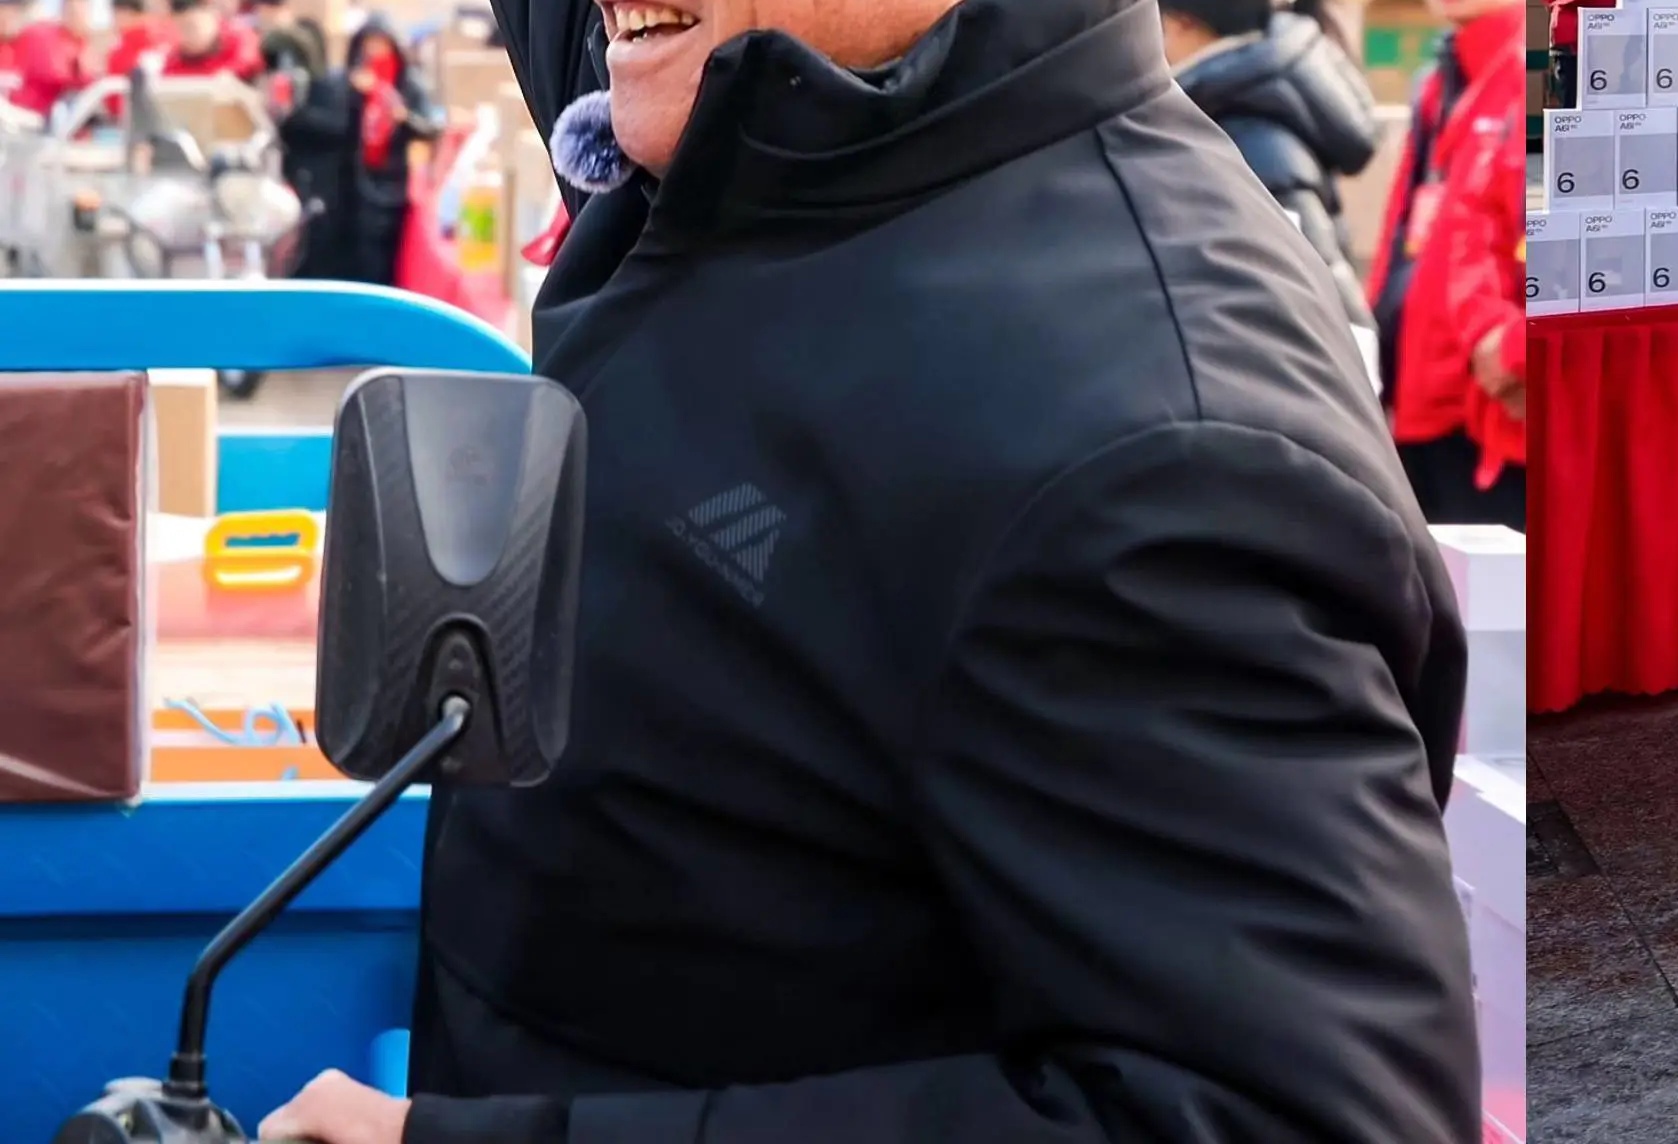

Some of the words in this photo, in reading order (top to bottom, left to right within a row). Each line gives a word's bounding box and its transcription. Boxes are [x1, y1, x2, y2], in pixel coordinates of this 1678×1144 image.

[1555, 116, 1582, 124] OPPO
[1619, 113, 1647, 122] OPPO
[1557, 172, 1575, 193] 6
[1622, 169, 1639, 190] 6
[1585, 216, 1612, 225] OPPO
[1651, 211, 1677, 221] OPPO
